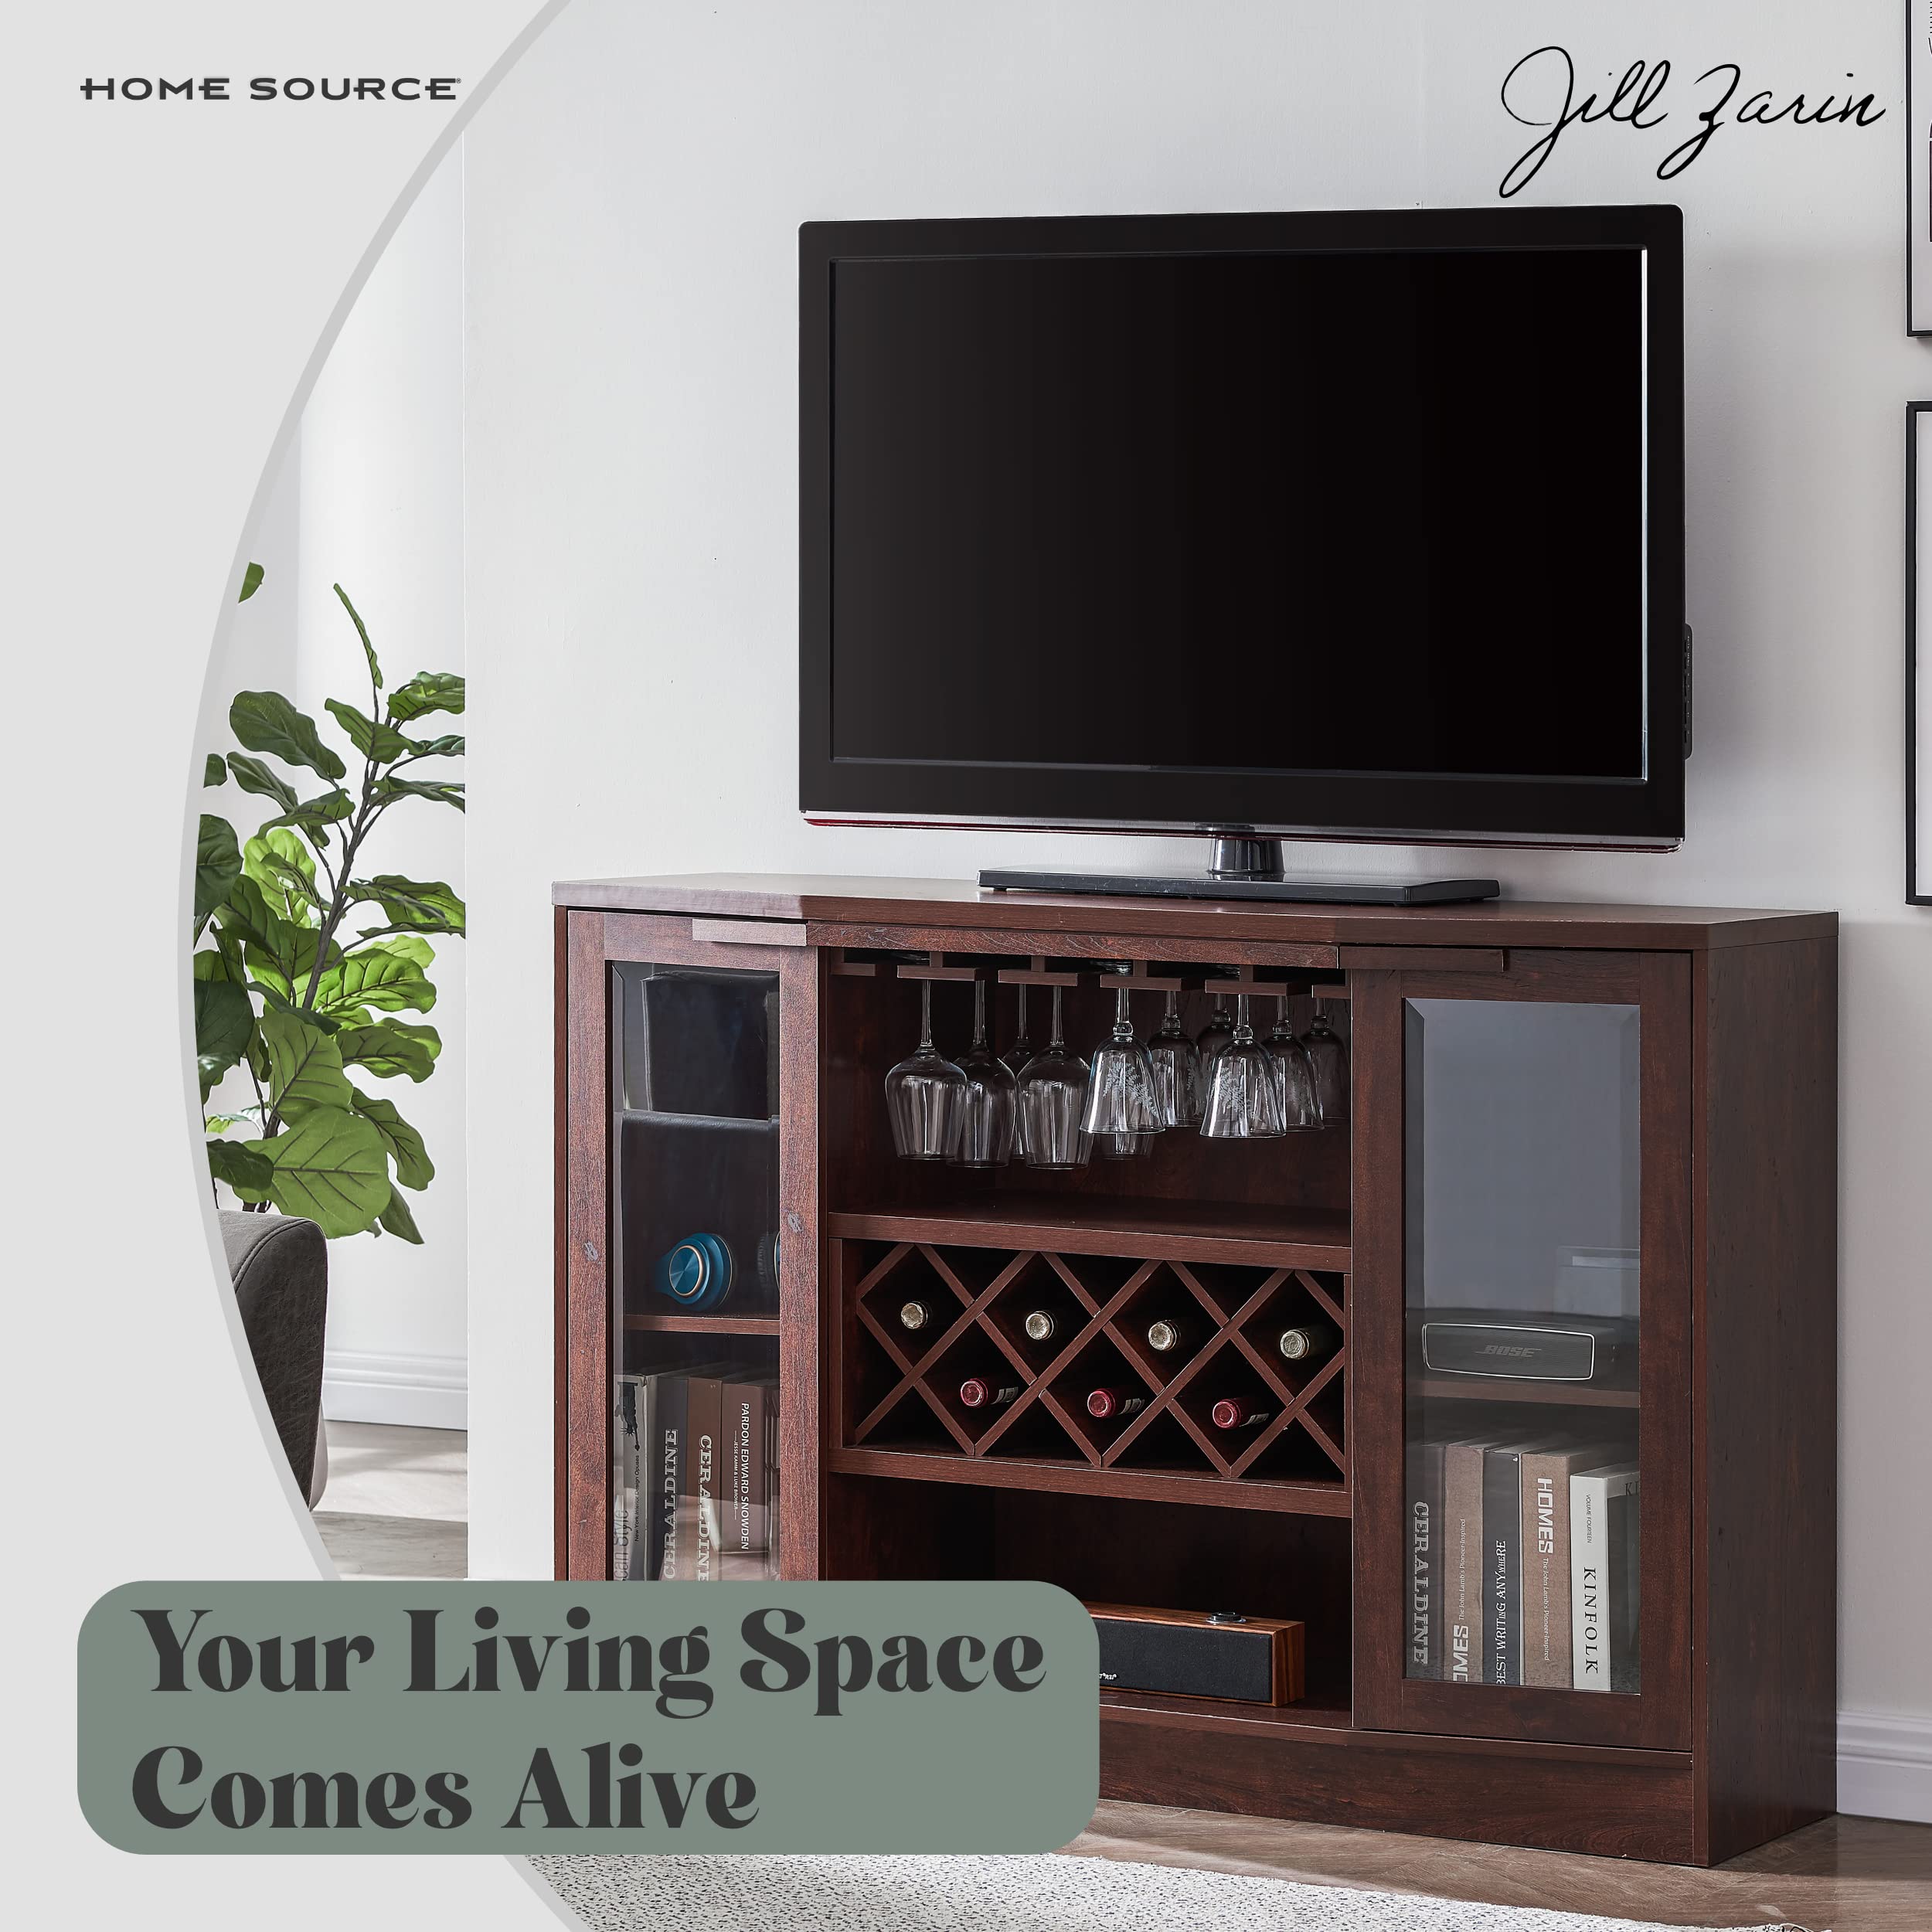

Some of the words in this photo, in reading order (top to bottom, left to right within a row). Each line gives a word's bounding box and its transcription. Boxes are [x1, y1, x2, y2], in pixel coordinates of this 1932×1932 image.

[1474, 1345, 1542, 1357] BOSE
[741, 1403, 750, 1446] PARDON
[741, 1449, 750, 1493] EDWARD
[741, 1496, 750, 1549] SNOWDEN
[1537, 1478, 1553, 1554] HOMES
[614, 1552, 629, 1580] can
[1583, 1566, 1598, 1674] KINFOLK
[1453, 1624, 1468, 1682] OMES
